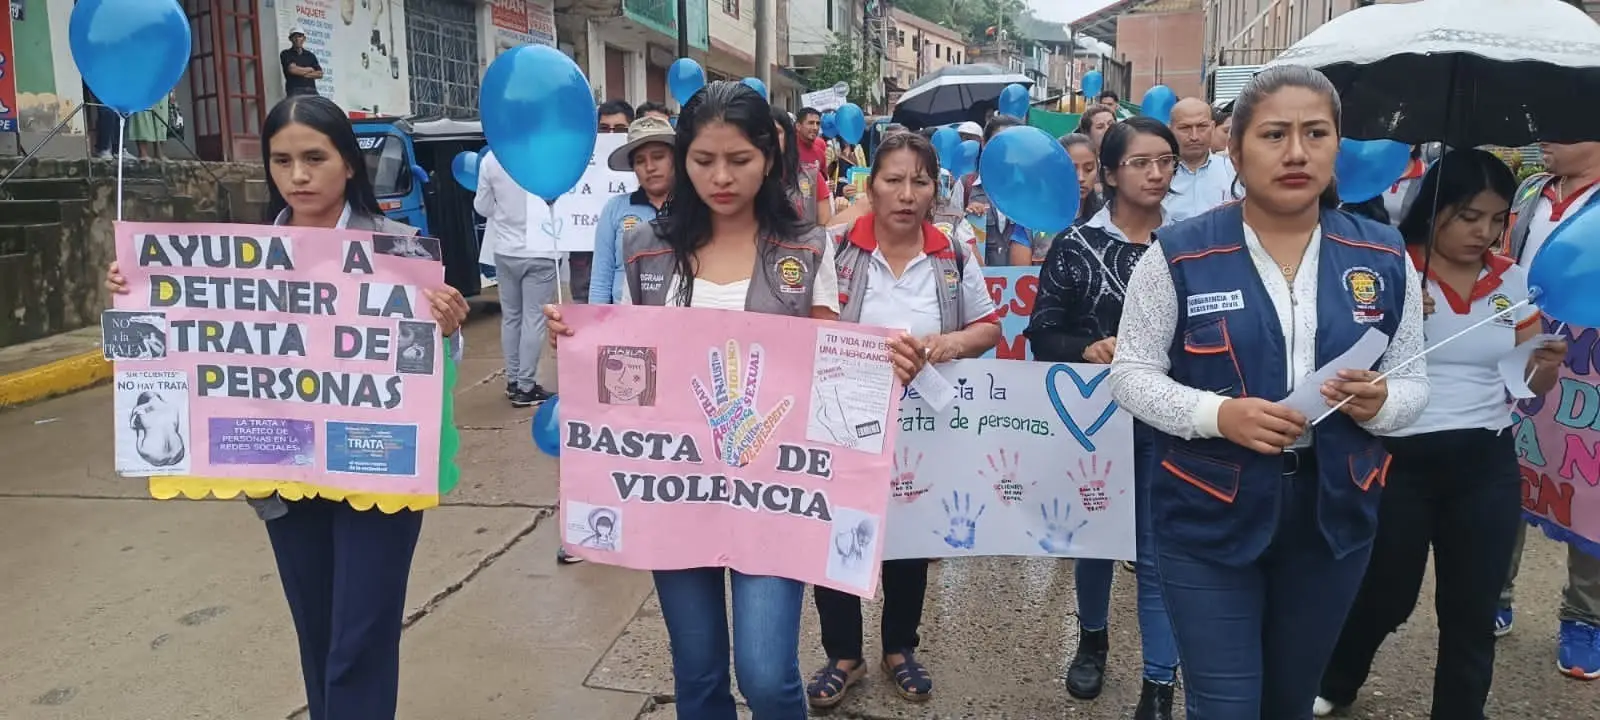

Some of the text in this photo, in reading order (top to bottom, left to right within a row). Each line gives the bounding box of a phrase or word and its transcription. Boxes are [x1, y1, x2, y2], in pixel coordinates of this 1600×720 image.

[296, 5, 327, 20] PAQUETE
[608, 182, 627, 193] LA
[139, 233, 373, 274] AYUDA A
[149, 274, 414, 319] DETENER LA
[112, 318, 130, 329] NO
[113, 331, 129, 342] a la
[171, 320, 390, 361] TRATA DE
[826, 334, 838, 342] TU
[840, 336, 860, 348] VIDA
[862, 340, 876, 349] NO
[104, 343, 144, 355] TRATA
[819, 346, 837, 355] UNA
[840, 350, 893, 364] MERCANCI
[118, 381, 188, 390] NO HAY TRATA
[197, 364, 402, 410] PERSONAS
[987, 373, 1007, 401] la
[712, 406, 744, 461] ABUSO
[743, 350, 760, 407] SEXUAL
[897, 406, 1056, 437] rata de personas.
[347, 438, 384, 449] TRATA
[566, 421, 702, 464] BASTA
[776, 444, 832, 478] DE
[610, 472, 833, 521] VIOLENCIA
